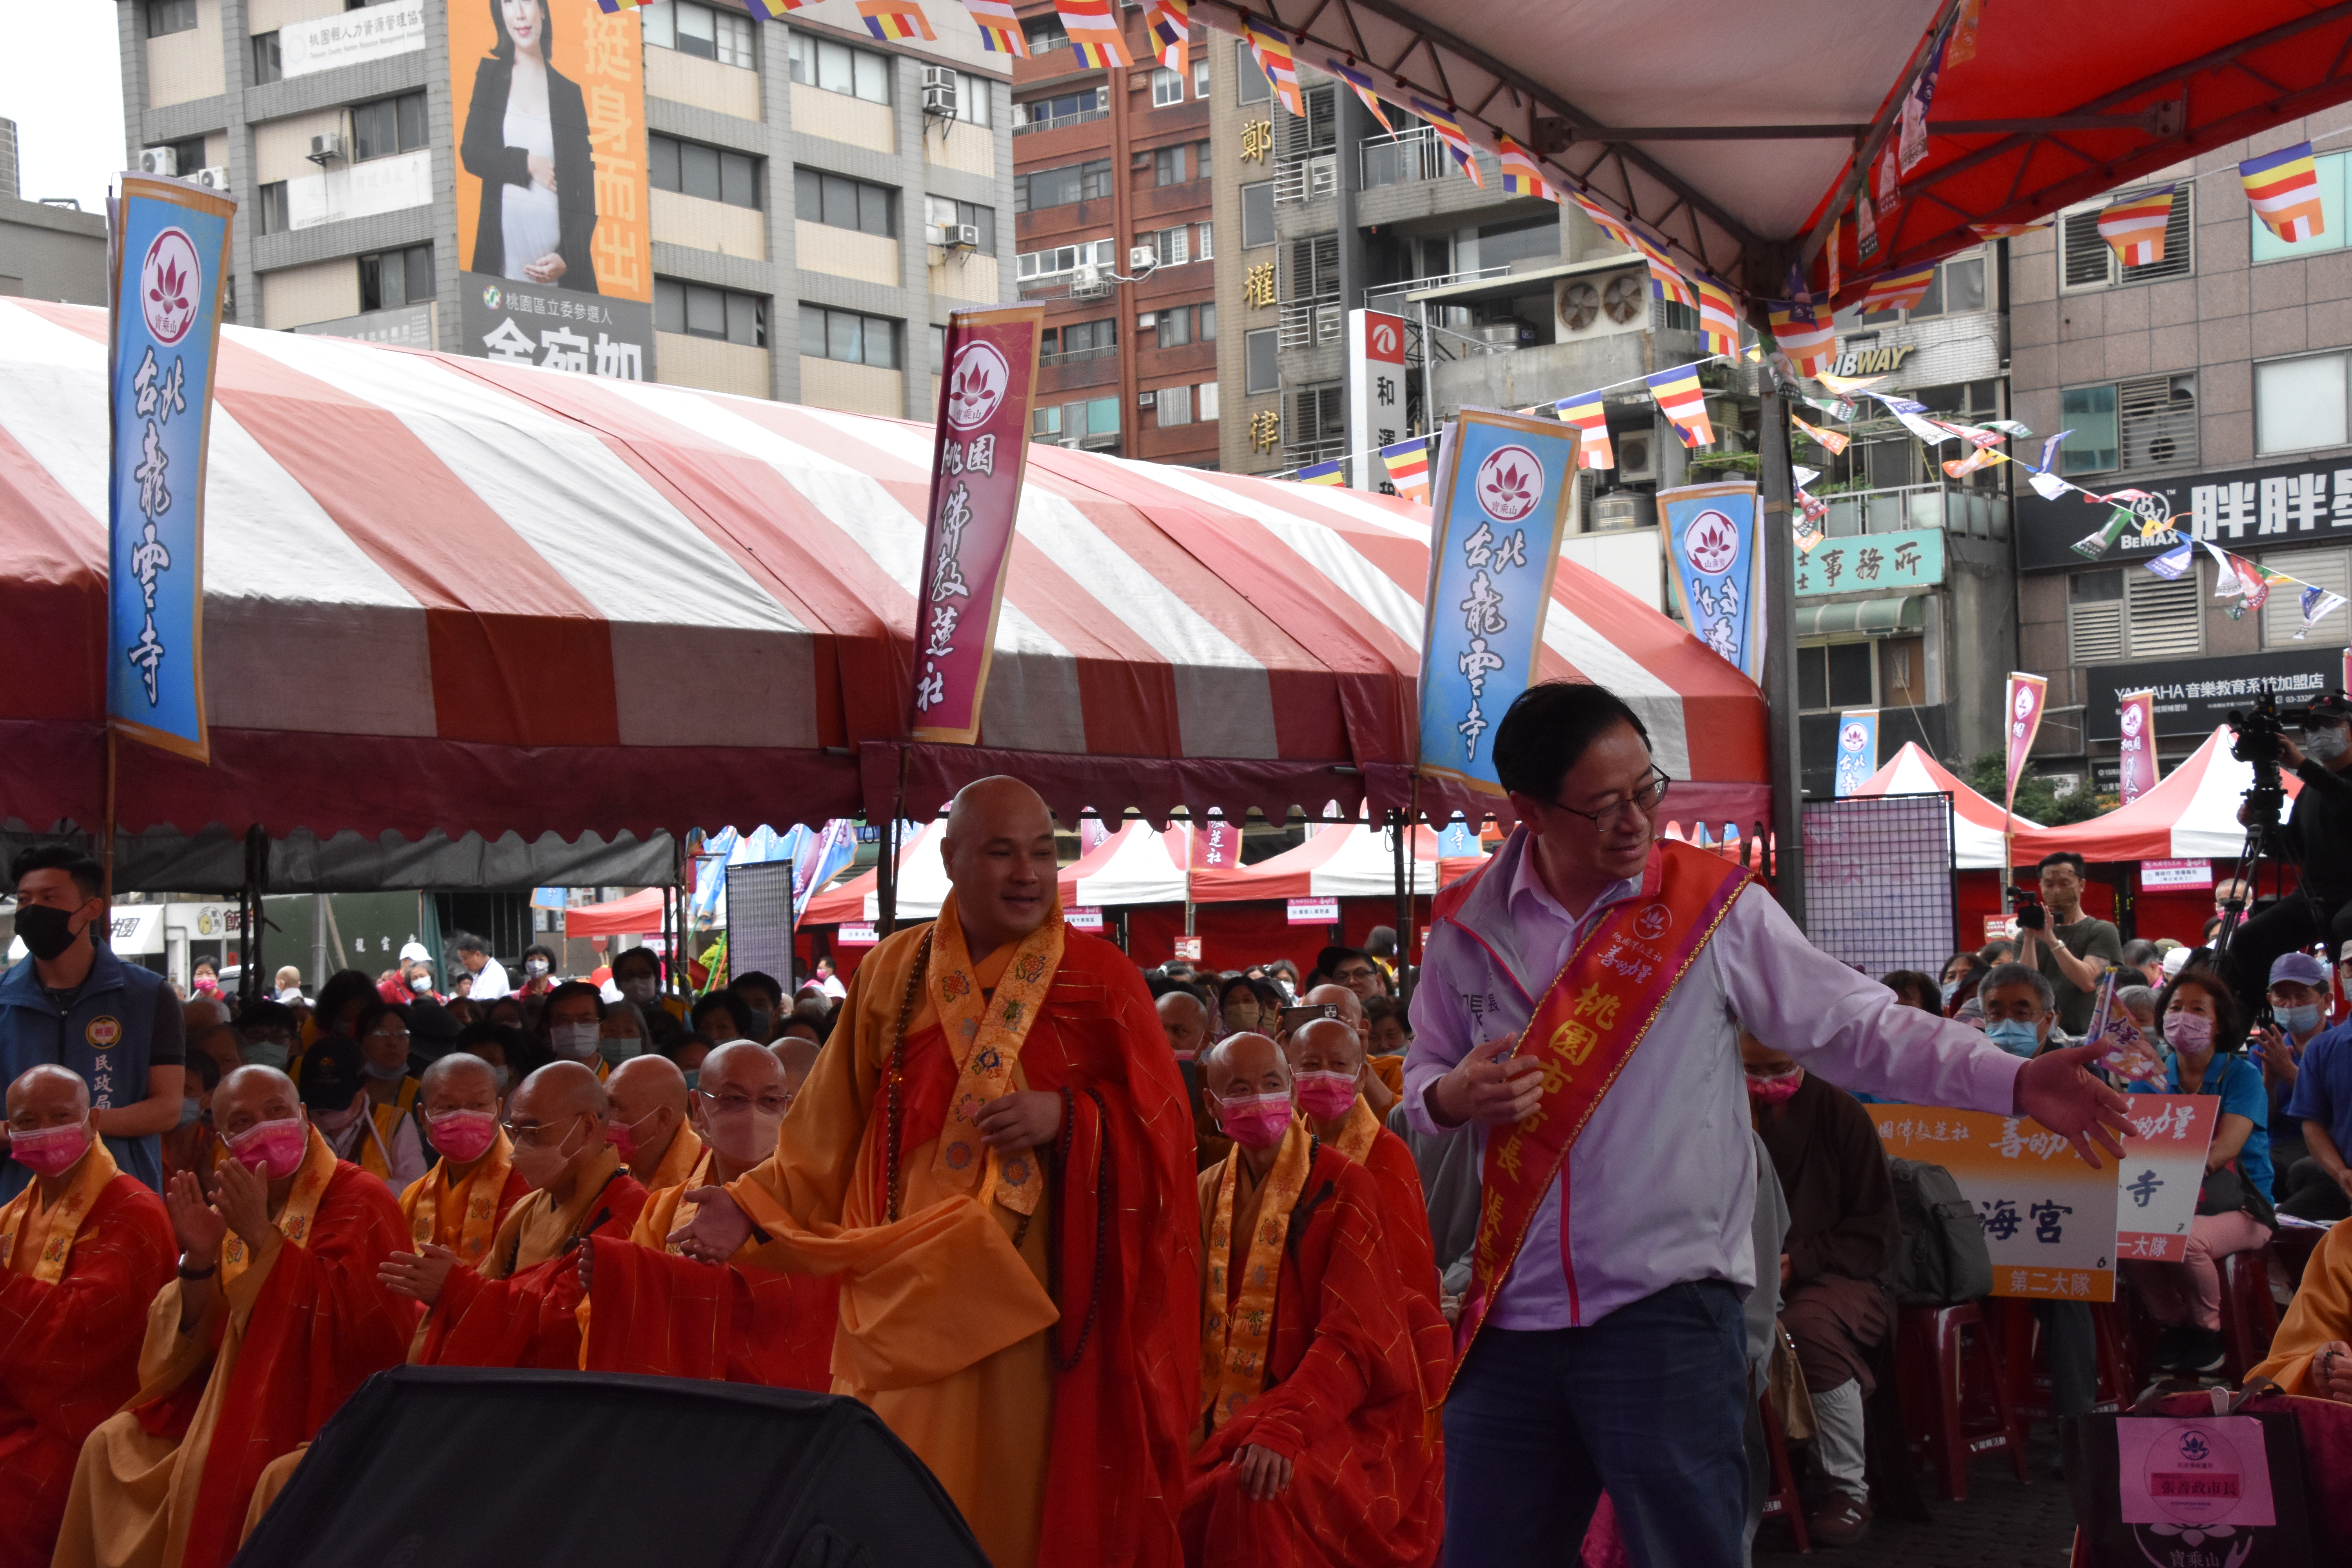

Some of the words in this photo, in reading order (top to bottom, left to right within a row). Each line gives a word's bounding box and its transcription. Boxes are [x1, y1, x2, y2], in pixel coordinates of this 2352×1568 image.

[583, 7, 640, 292] 挺身而出
[1240, 120, 1279, 454] 鄭權律
[154, 314, 177, 335] 寶乘山
[506, 292, 613, 325] 桃園區立委參選人
[1826, 344, 1915, 377] UBWAY
[132, 345, 187, 426] 台北
[956, 408, 981, 421] 寶乘山
[1491, 500, 1518, 516] 寶乘山
[1463, 522, 1526, 573] 台北
[1820, 541, 1922, 588] 事務所
[2114, 684, 2185, 702] YAAHA
[2185, 673, 2325, 699] 音樂教育系統加盟店
[1839, 753, 1866, 771] 台北
[93, 1053, 114, 1109] 民政局
[2126, 1096, 2196, 1140] 的力量
[1989, 1117, 2091, 1160] 善的力
[2126, 1169, 2164, 1208] 寺
[2010, 1270, 2091, 1296] 第二大隊
[2161, 1481, 2237, 1496] 張善政市長
[2169, 1549, 2220, 1568] 寶乘山
